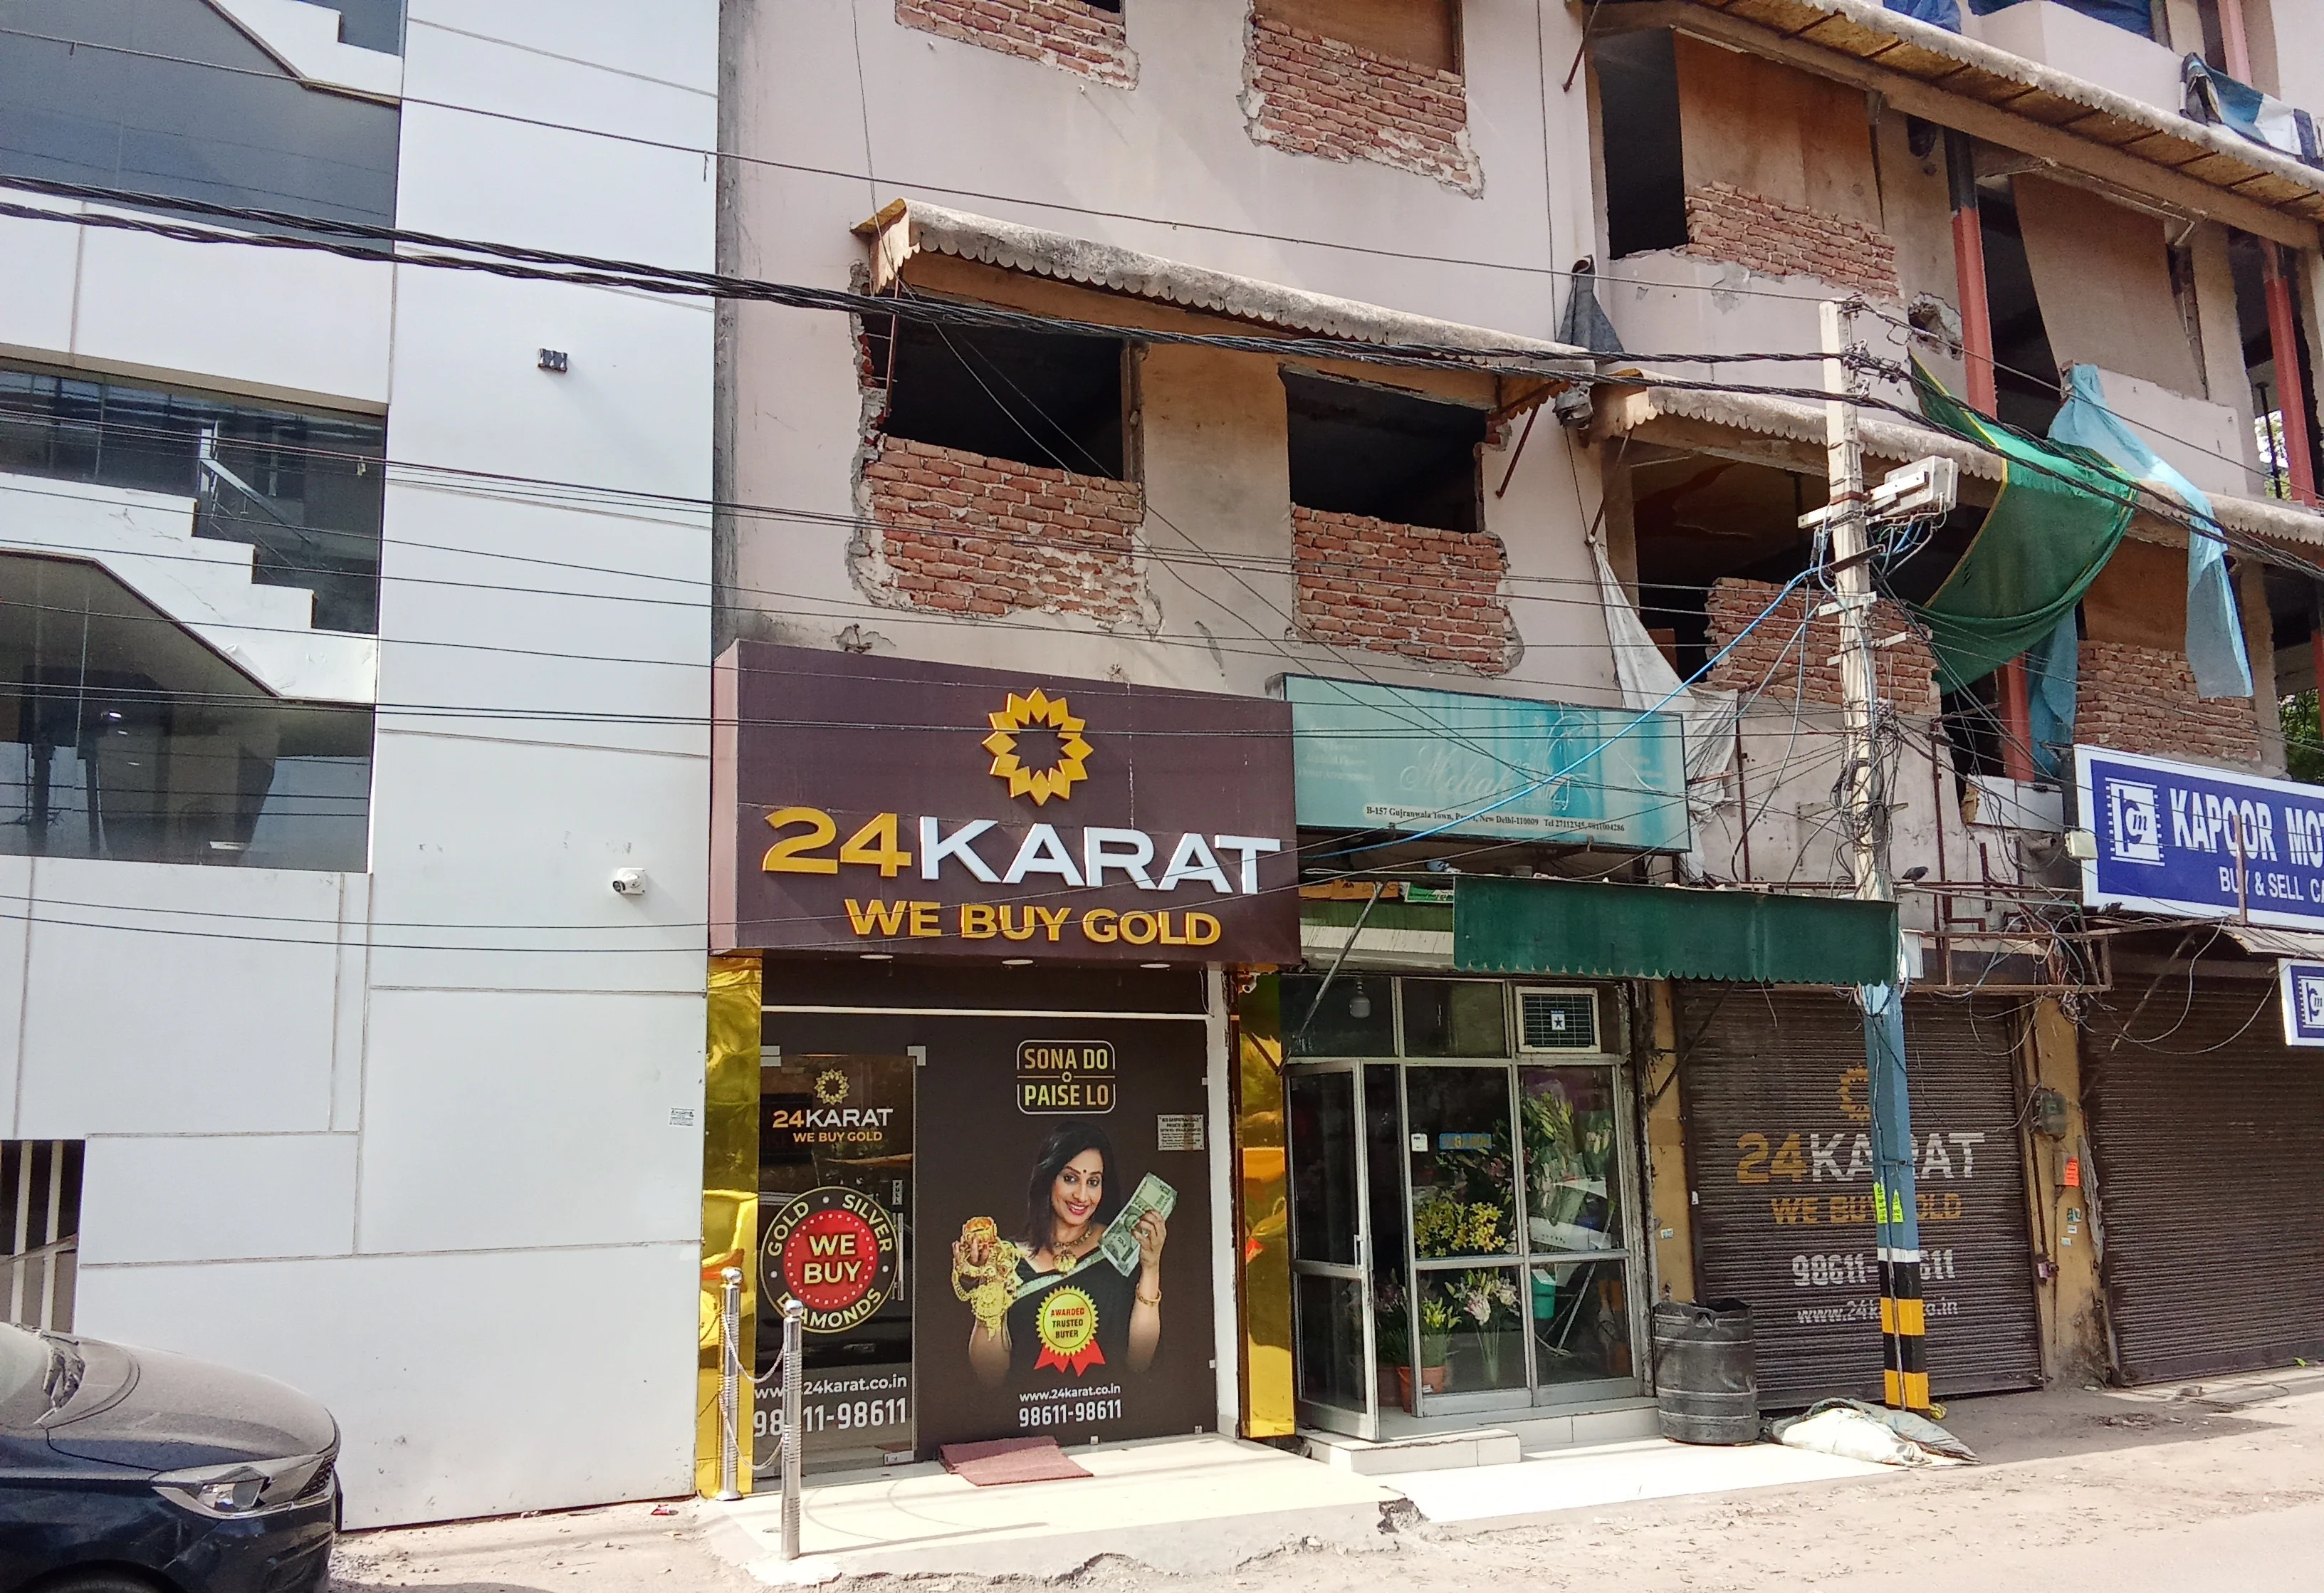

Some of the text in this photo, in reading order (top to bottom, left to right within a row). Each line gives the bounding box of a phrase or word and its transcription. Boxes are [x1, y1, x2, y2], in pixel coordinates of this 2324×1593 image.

[1366, 805, 1388, 815] B-157
[1388, 808, 1431, 818] Gujranwala
[2169, 788, 2278, 862] KAPOOR
[762, 806, 1282, 894] 24KARAT
[2255, 872, 2266, 897] &
[2268, 872, 2304, 901] SELL
[2310, 879, 2324, 904] C
[844, 898, 1222, 946] WE BUY GOLD
[1025, 1048, 1108, 1070] SONA DO
[1025, 1084, 1109, 1106] PAISE LO
[773, 1108, 894, 1128] 24KARAT
[793, 1131, 882, 1143] WE BUY GOLD
[1736, 1132, 1985, 1184] 24KAAT
[1771, 1197, 1818, 1224] WE
[1829, 1196, 1875, 1223] BU
[1915, 1193, 1962, 1221] OLD
[768, 1200, 809, 1256] GOLD
[842, 1194, 893, 1253] SILVER
[809, 1234, 857, 1256] WE
[804, 1260, 862, 1284] BUY
[1792, 1249, 1956, 1286] 98611-611
[776, 1288, 881, 1329] DAMONDS
[1050, 1307, 1085, 1317] AWARDED
[1052, 1319, 1084, 1328] TRUSTED
[1055, 1330, 1079, 1339] BUYER
[755, 1374, 907, 1399] ww.24karat.co.in
[1020, 1382, 1121, 1402] www.24karat.co.in
[753, 1397, 906, 1437] 9811-98611
[1019, 1399, 1121, 1427] 98611-98611
